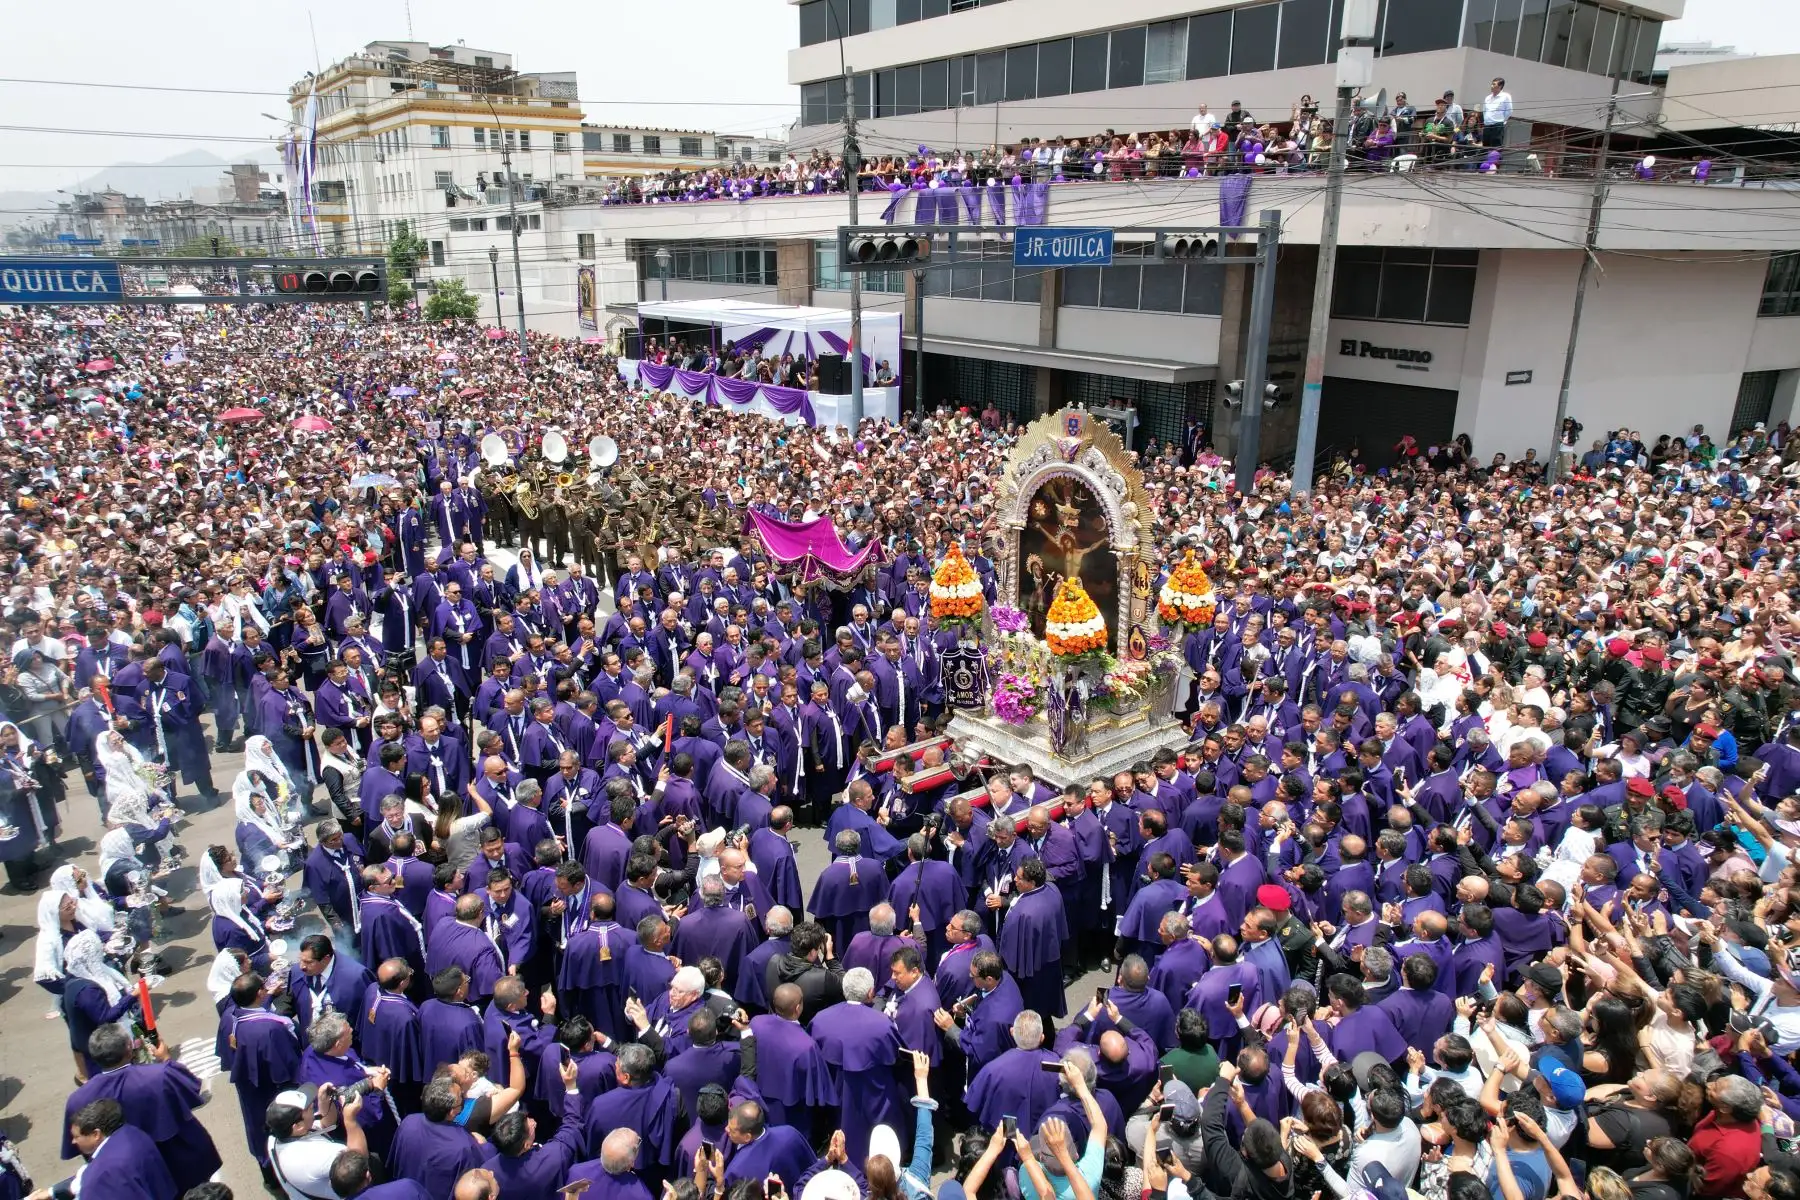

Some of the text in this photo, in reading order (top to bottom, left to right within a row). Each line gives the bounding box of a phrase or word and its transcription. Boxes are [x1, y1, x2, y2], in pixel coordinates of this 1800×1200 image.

[1023, 236, 1104, 257] JR. QUILCA
[2, 268, 108, 293] QUILCA
[283, 273, 298, 289] 17
[1339, 339, 1432, 364] El Peruano
[956, 691, 974, 699] AMOR
